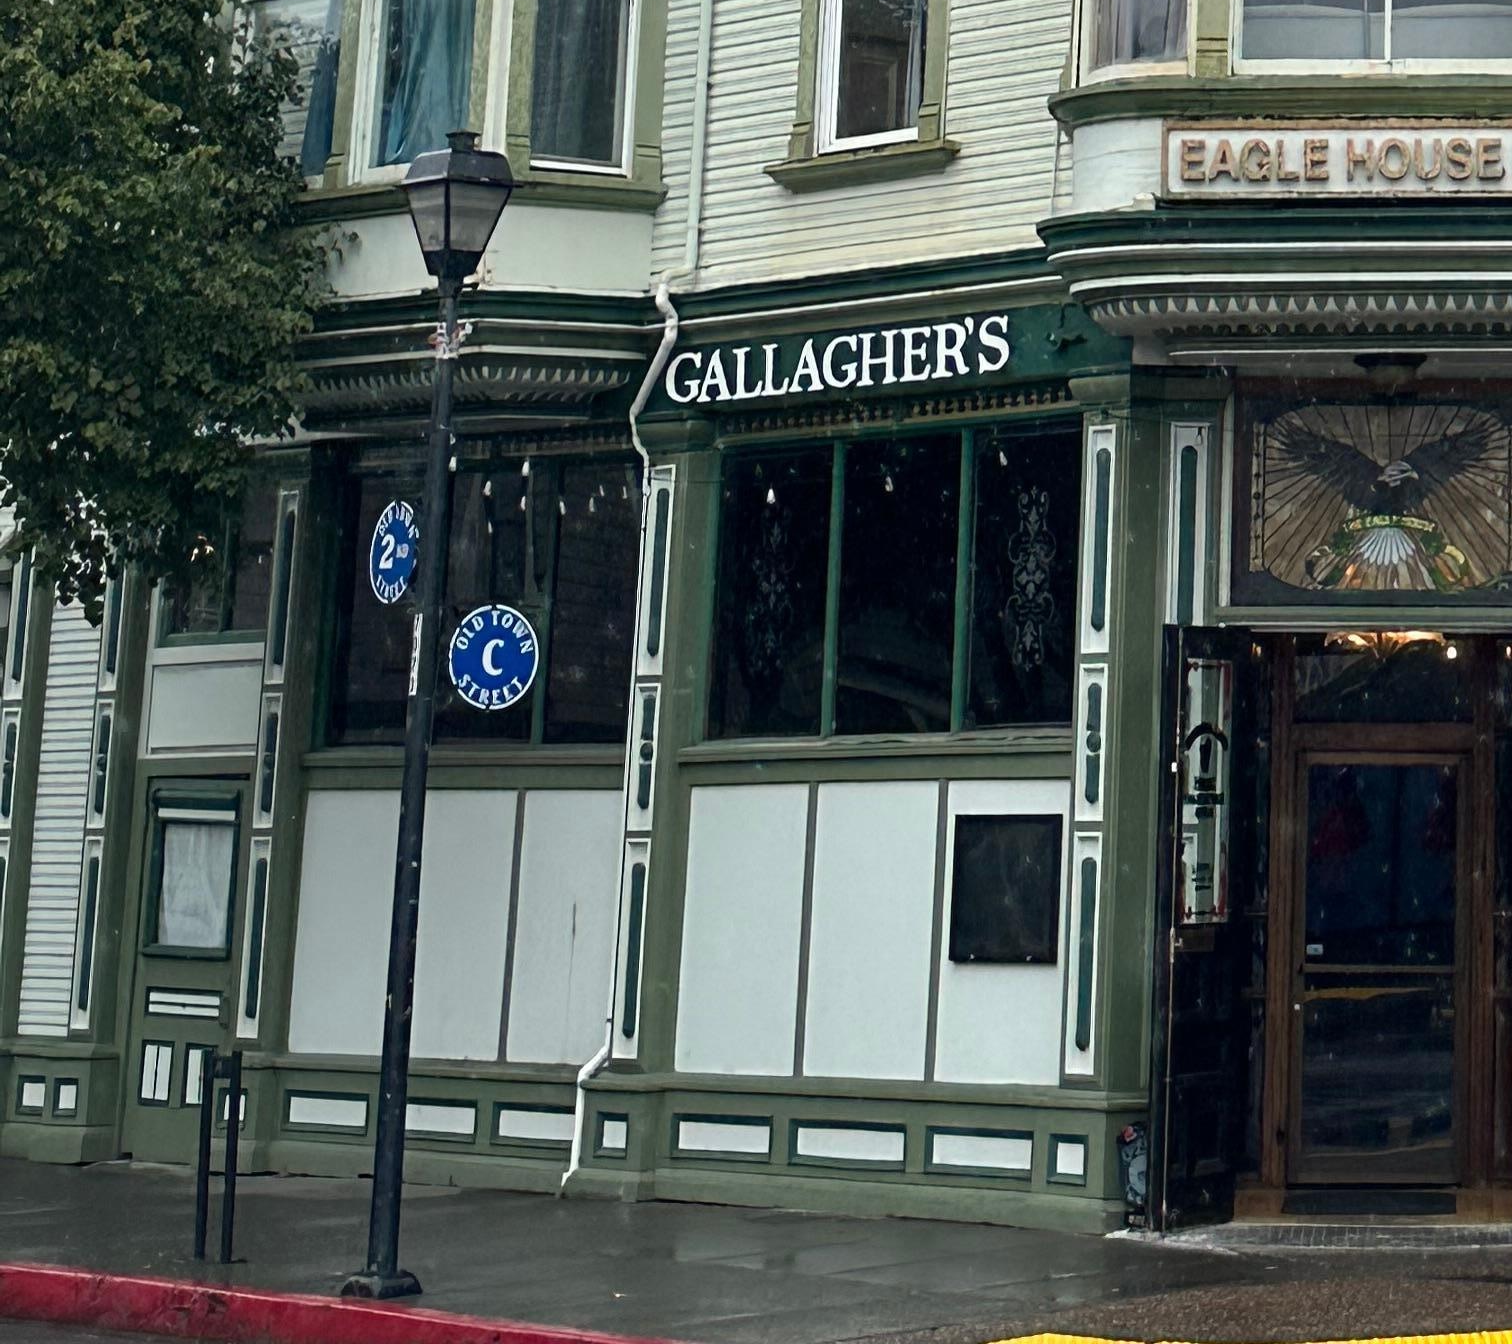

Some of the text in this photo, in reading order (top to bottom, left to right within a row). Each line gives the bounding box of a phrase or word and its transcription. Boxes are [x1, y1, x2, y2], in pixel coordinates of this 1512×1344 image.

[1181, 138, 1329, 182] EAGLE
[1346, 138, 1505, 181] HOUSE
[665, 315, 1010, 403] GALLAGHER'S
[456, 610, 534, 654] OLD TOWN
[482, 638, 505, 676] C
[458, 674, 524, 705] STREET
